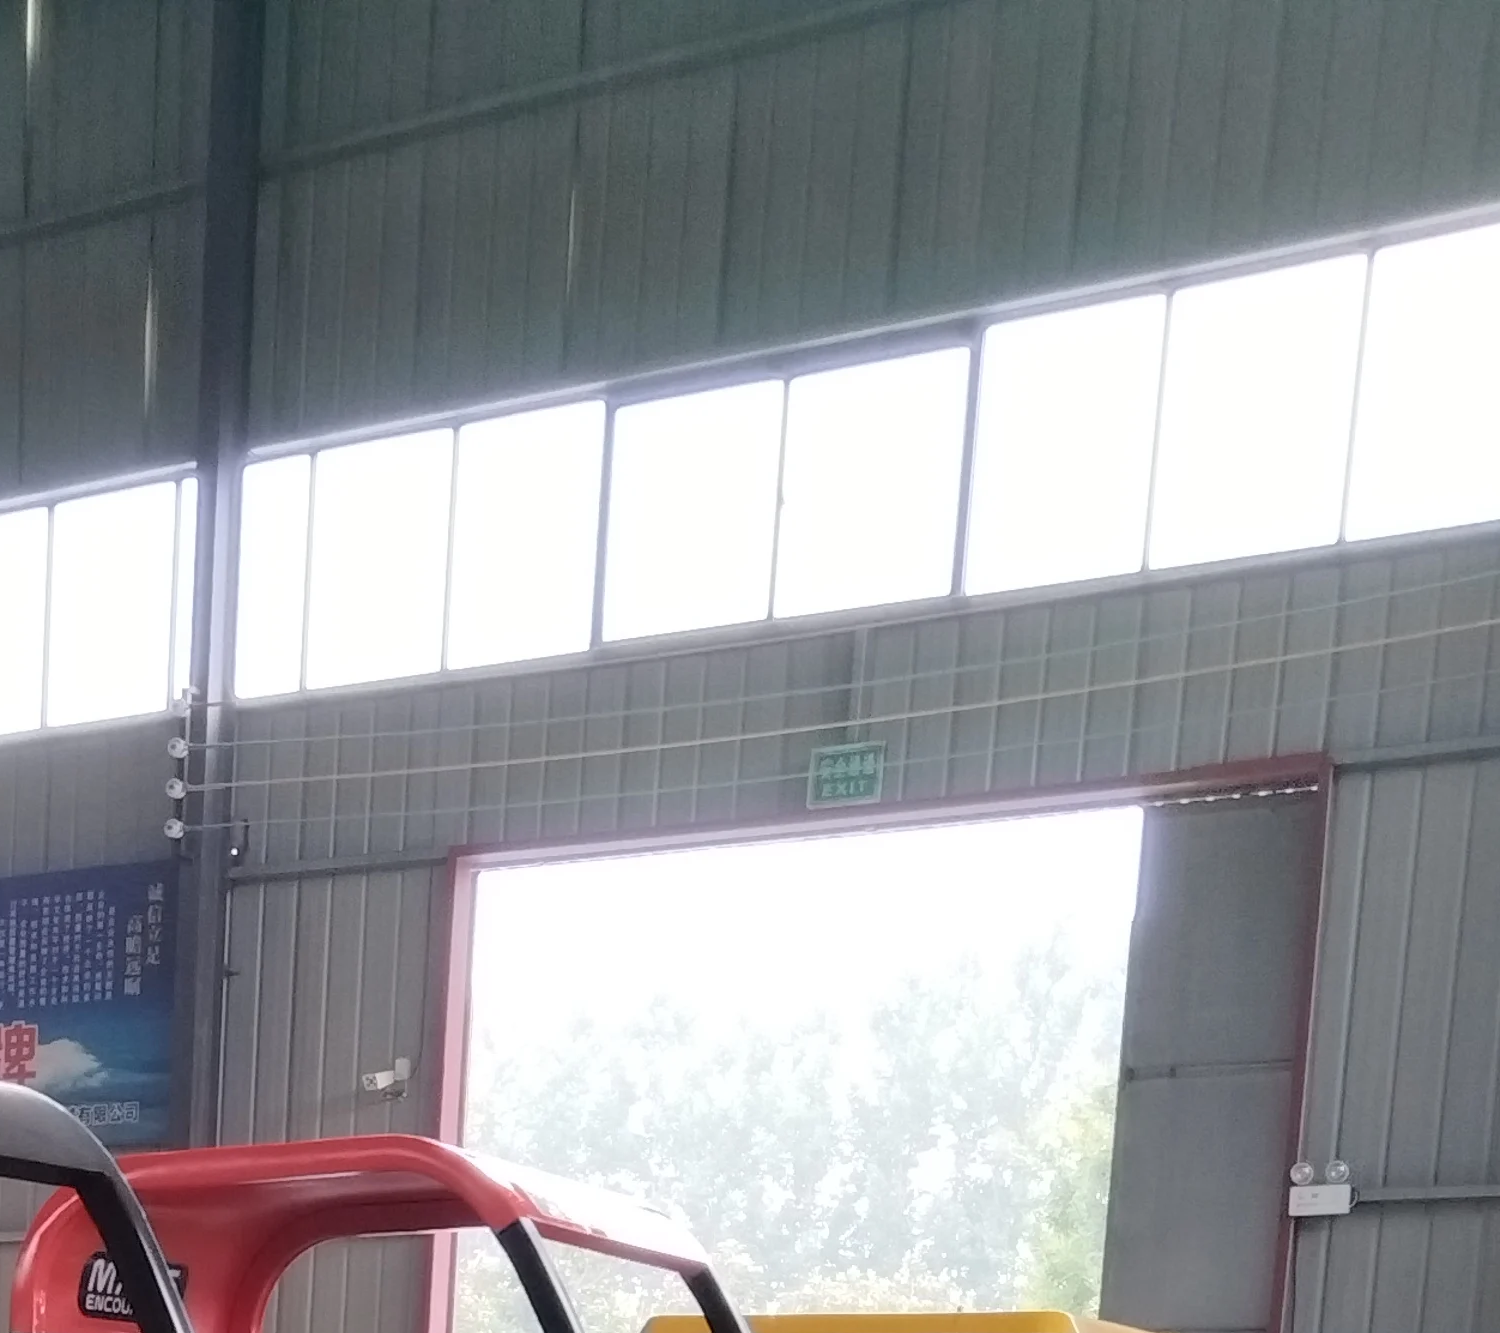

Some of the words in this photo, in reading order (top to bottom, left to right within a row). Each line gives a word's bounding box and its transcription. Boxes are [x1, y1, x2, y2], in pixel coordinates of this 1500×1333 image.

[821, 780, 869, 797] EXIT
[68, 1101, 140, 1127] 有限公司
[85, 1293, 134, 1316] ENCOU
